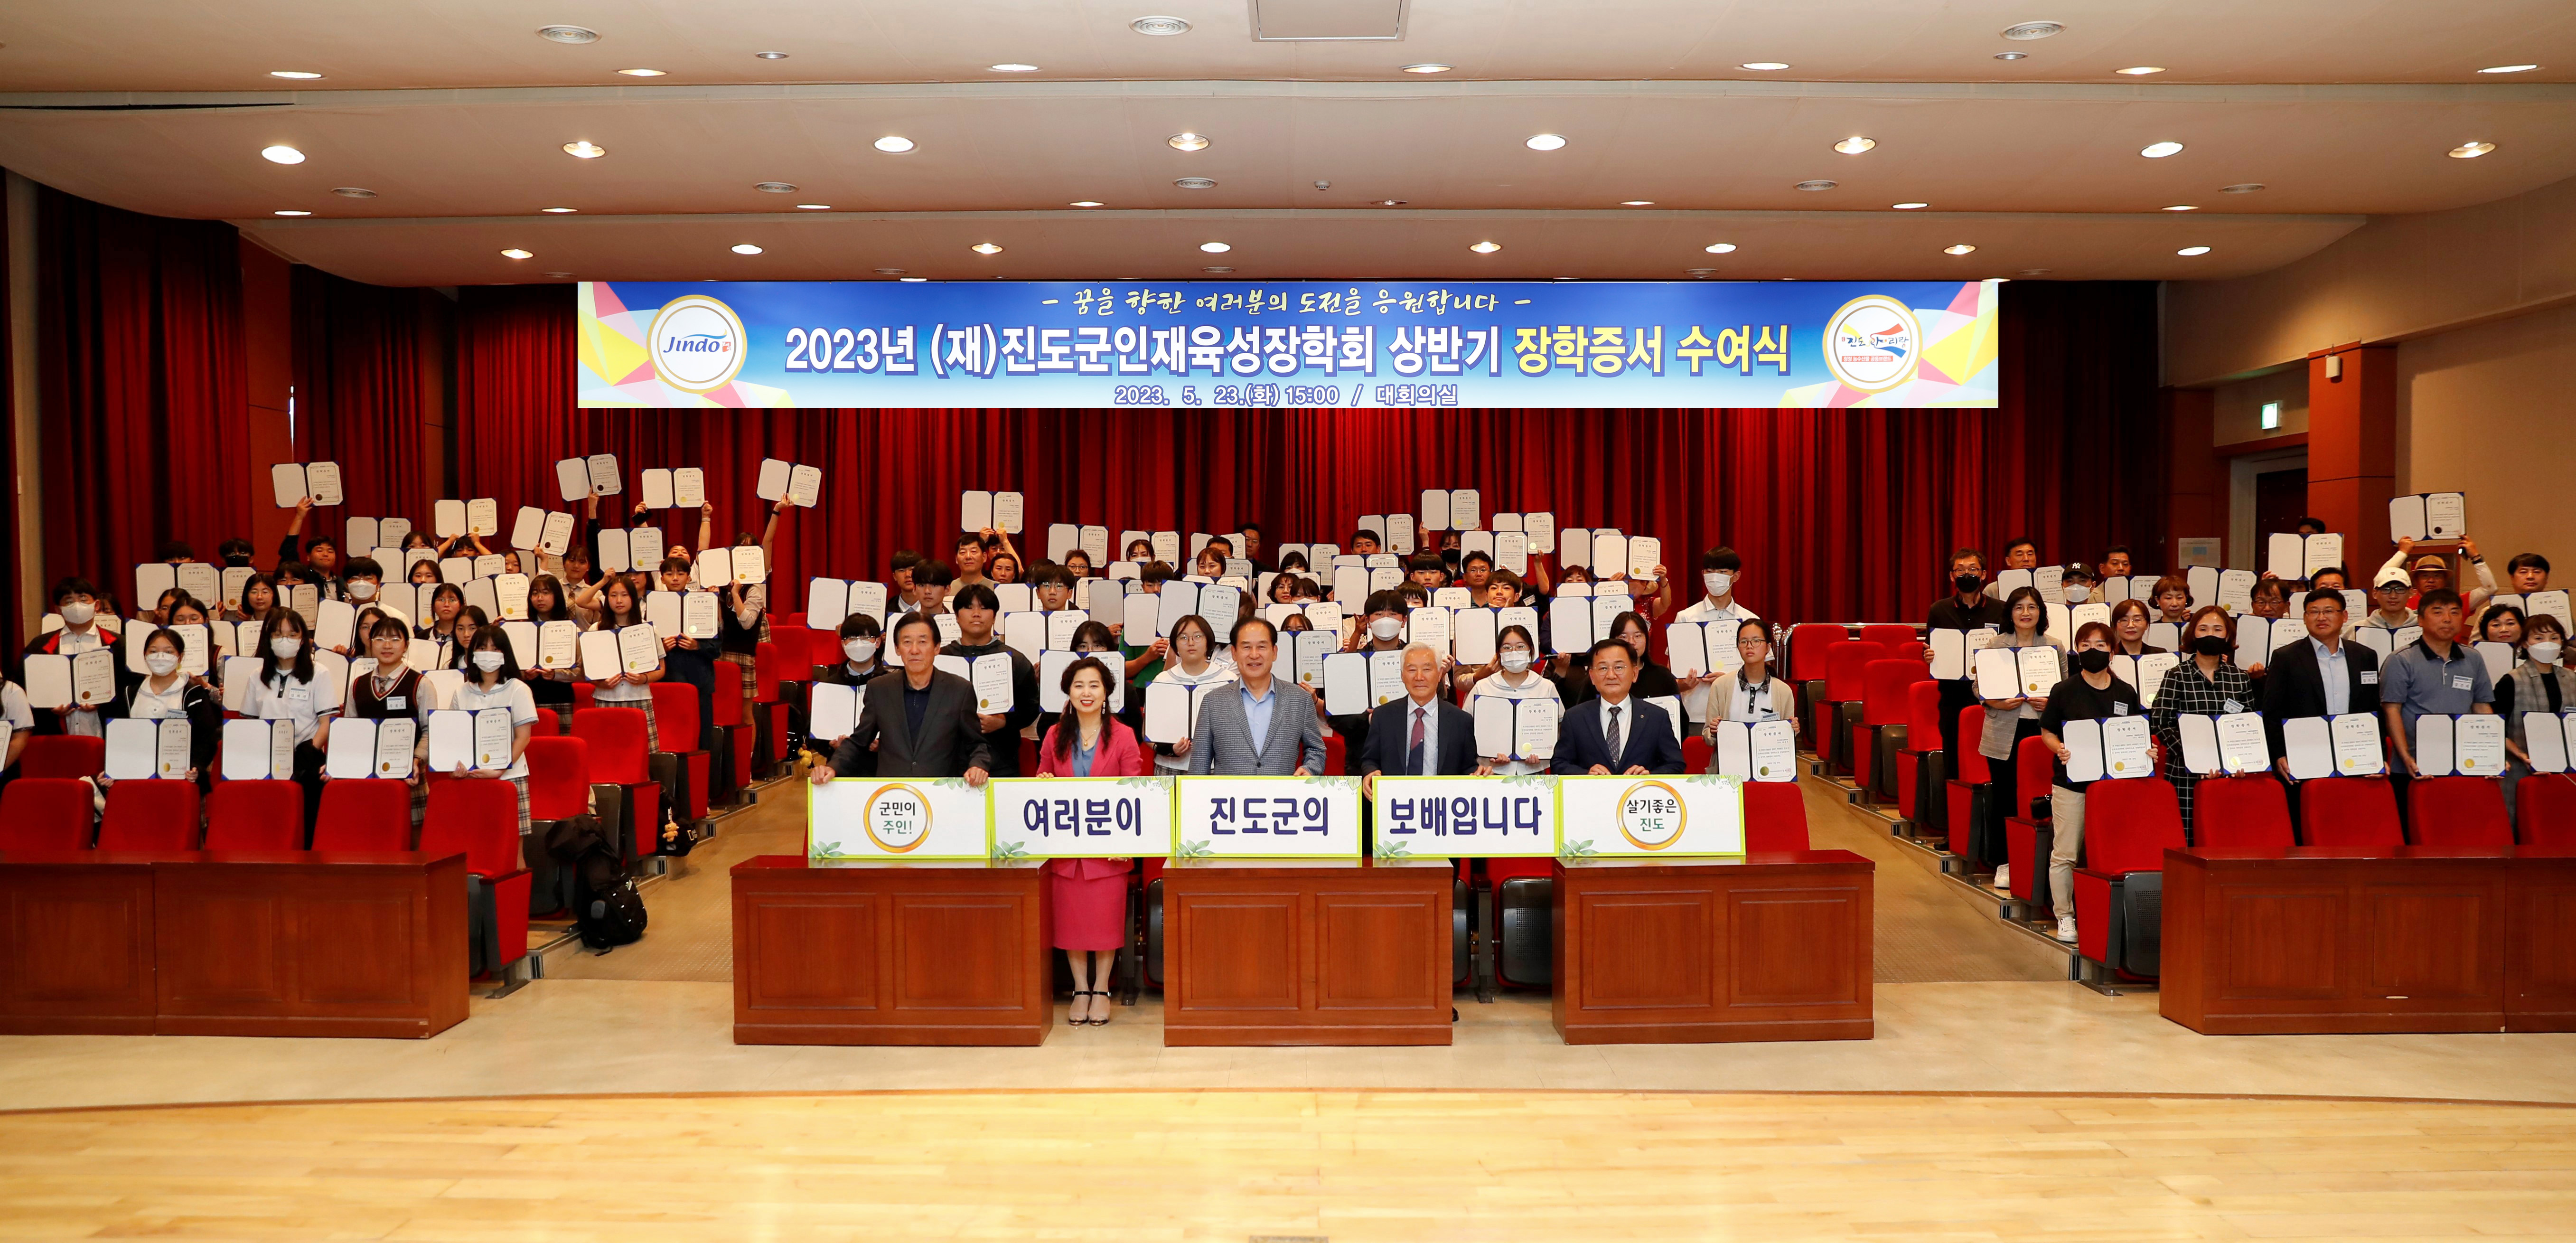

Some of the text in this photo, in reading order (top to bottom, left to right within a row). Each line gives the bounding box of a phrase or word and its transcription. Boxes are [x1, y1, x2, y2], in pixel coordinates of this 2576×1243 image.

[1073, 288, 1115, 316] 꿈을
[1125, 289, 1186, 315] 향한
[1196, 289, 1287, 315] 여러분의
[1299, 288, 1361, 316] 도전을
[1372, 289, 1499, 315] 응원합니다
[663, 337, 720, 353] Jindo
[786, 323, 1791, 378] 2023년 (재)진도군인재육성장학회 상반기 장학증서 수여식
[1115, 385, 1169, 405] 2023.
[1181, 386, 1201, 405] 5.
[1285, 385, 1340, 405] 15:00
[1376, 384, 1458, 406] 대회의실
[878, 801, 916, 817] 군민이
[1023, 798, 1141, 837] 여러분이
[1210, 796, 1329, 837] 진도군의
[1389, 796, 1542, 837] 보배입니다
[1626, 799, 1677, 814] 살기좋은
[883, 819, 913, 836] 주인!
[1640, 817, 1665, 832] 진도
